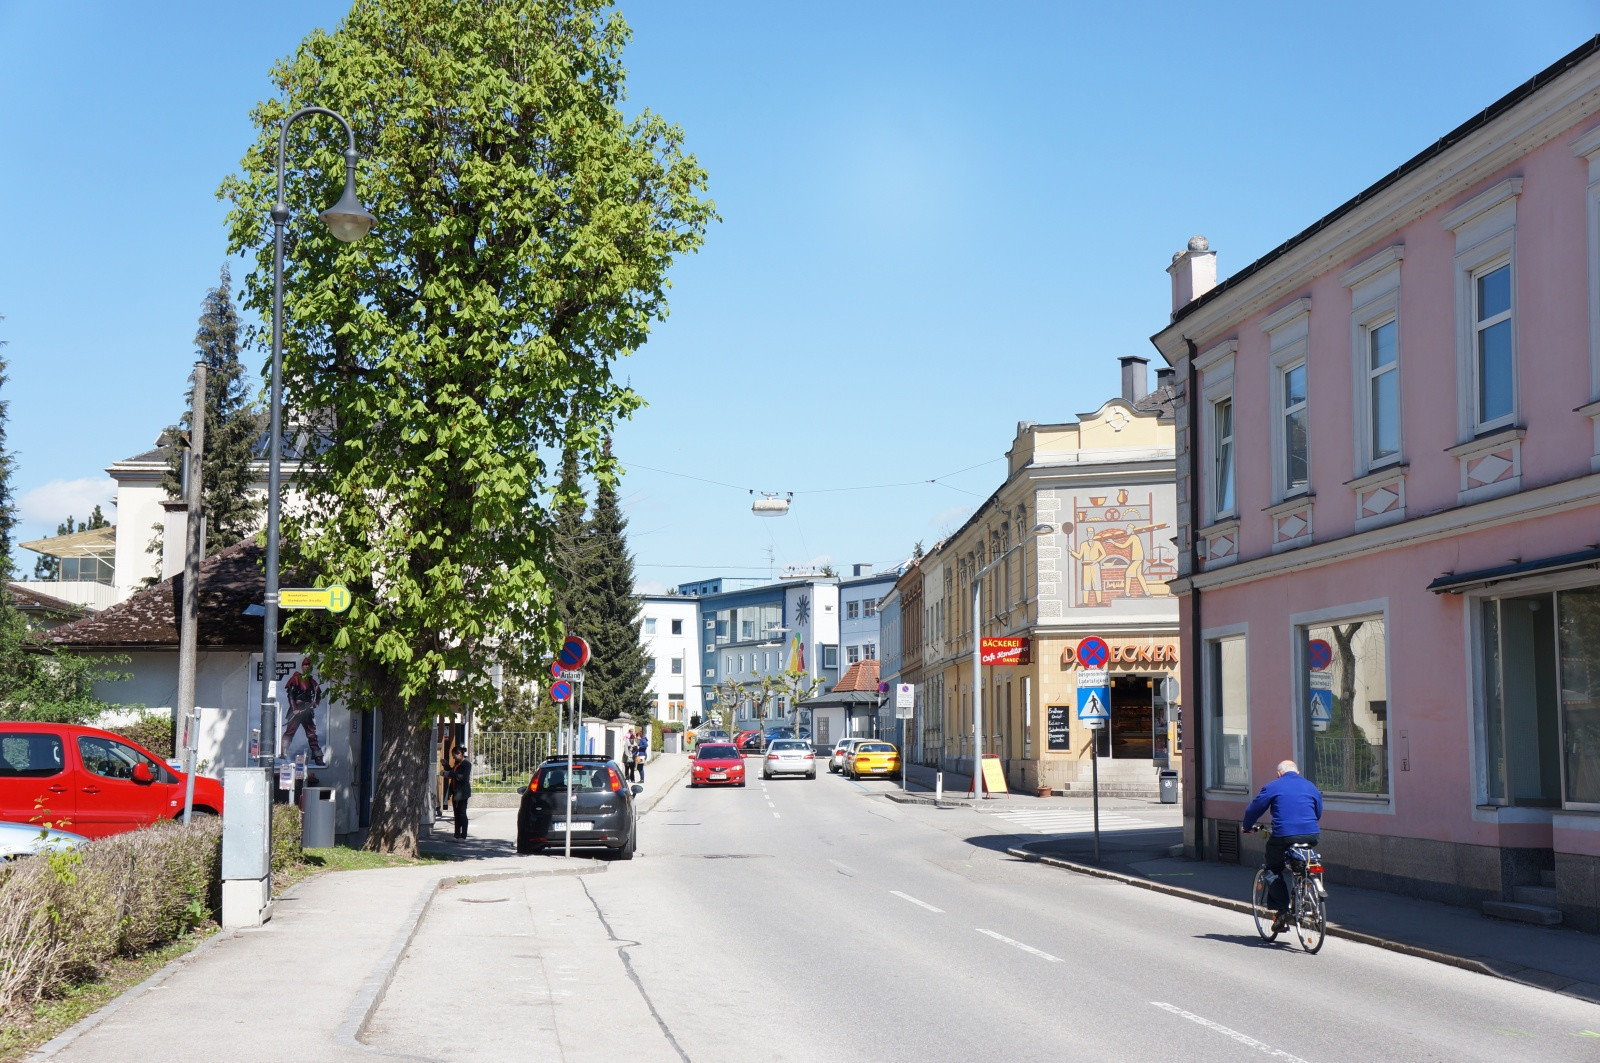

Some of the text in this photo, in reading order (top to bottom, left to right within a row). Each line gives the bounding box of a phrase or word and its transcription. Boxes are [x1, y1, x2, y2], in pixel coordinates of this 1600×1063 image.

[330, 591, 344, 607] H
[982, 639, 1019, 648] BÄCKEREI
[1062, 644, 1179, 663] DECKER
